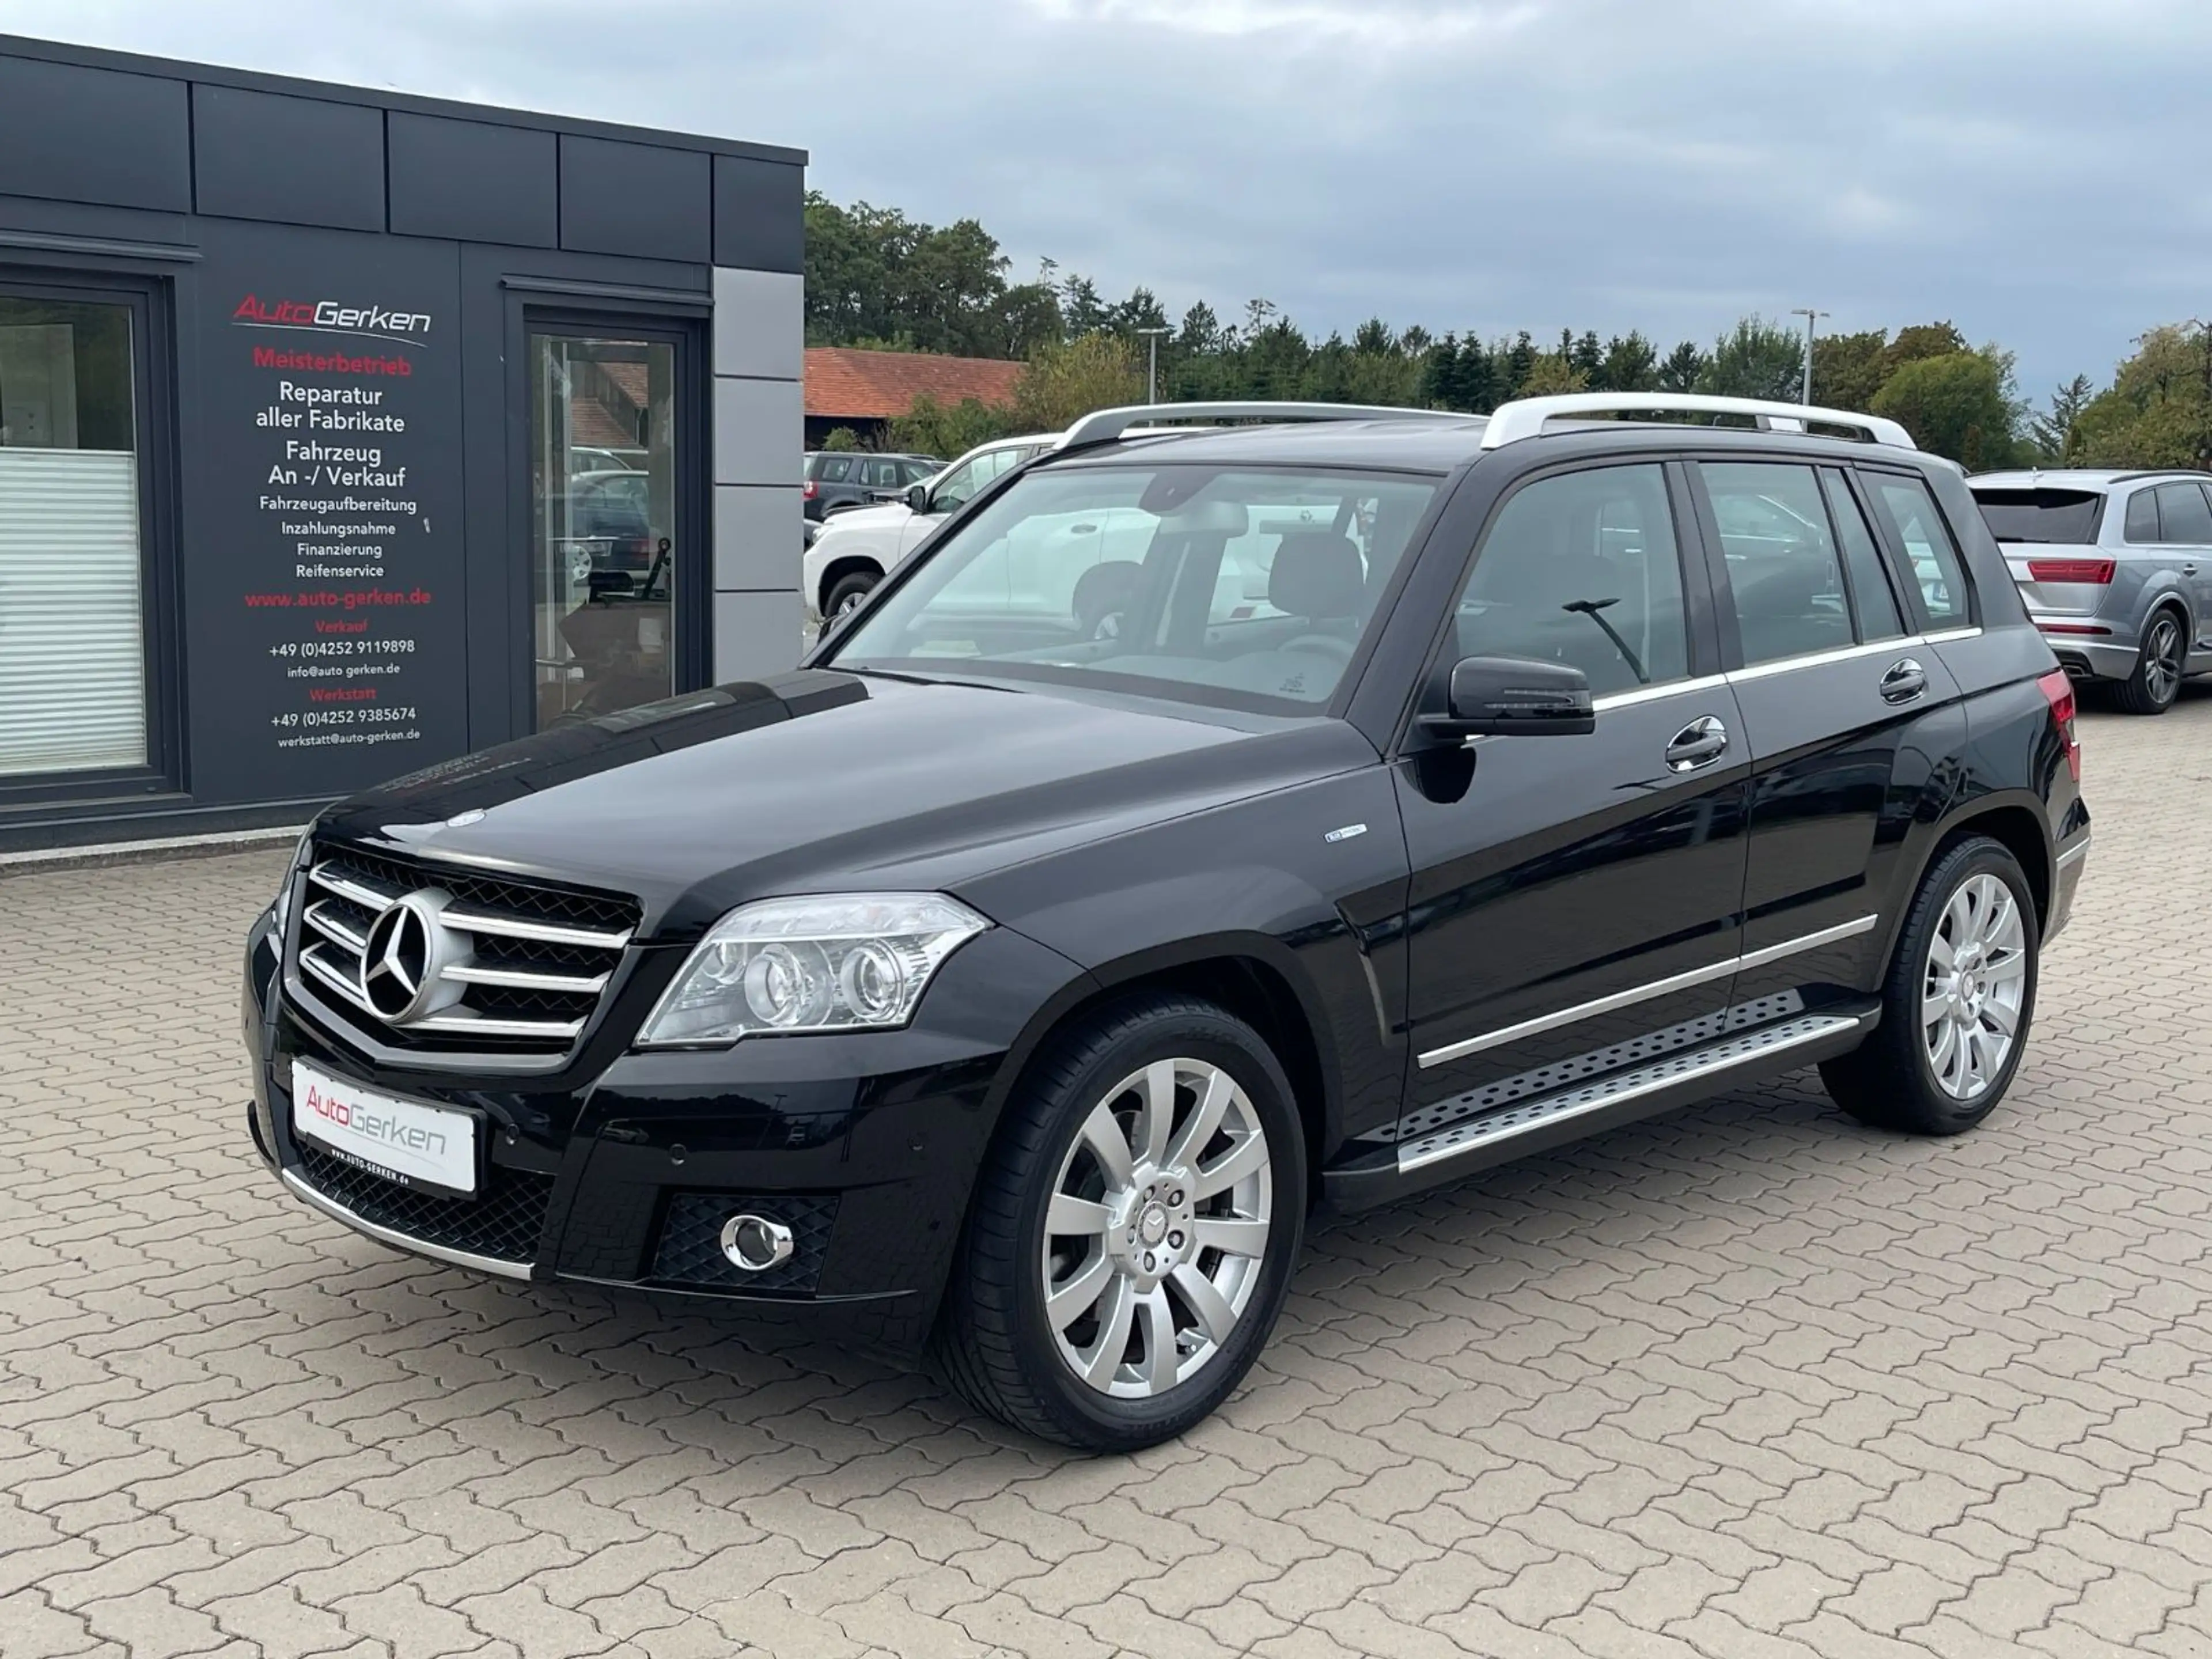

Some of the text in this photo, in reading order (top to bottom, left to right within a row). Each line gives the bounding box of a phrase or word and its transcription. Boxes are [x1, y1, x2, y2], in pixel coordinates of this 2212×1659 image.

[233, 293, 431, 332] AutoGerken
[253, 347, 412, 376] Meisterbetrieb
[279, 381, 382, 407] Reparatur
[256, 406, 405, 432] aller Fabrikate
[286, 440, 381, 467] Fahrzeug
[268, 464, 297, 484] An
[326, 467, 406, 487] Verkauf
[260, 495, 416, 515] Fahrzeugaufbereitung
[282, 521, 396, 538] Inzahlungsnahme
[297, 543, 382, 559] Finanzierung
[296, 563, 384, 577] Reifenservice
[245, 588, 431, 609] www.auto-gerken.de
[315, 619, 369, 633] Verkauf
[269, 639, 415, 658] +49 (0)4252 9119898
[309, 688, 377, 702] Werkstatt
[271, 707, 416, 727] +49 (0)4252 9385674
[278, 729, 420, 747] werkstatt@auto-gerken.de
[306, 1085, 446, 1154] AutoGerken
